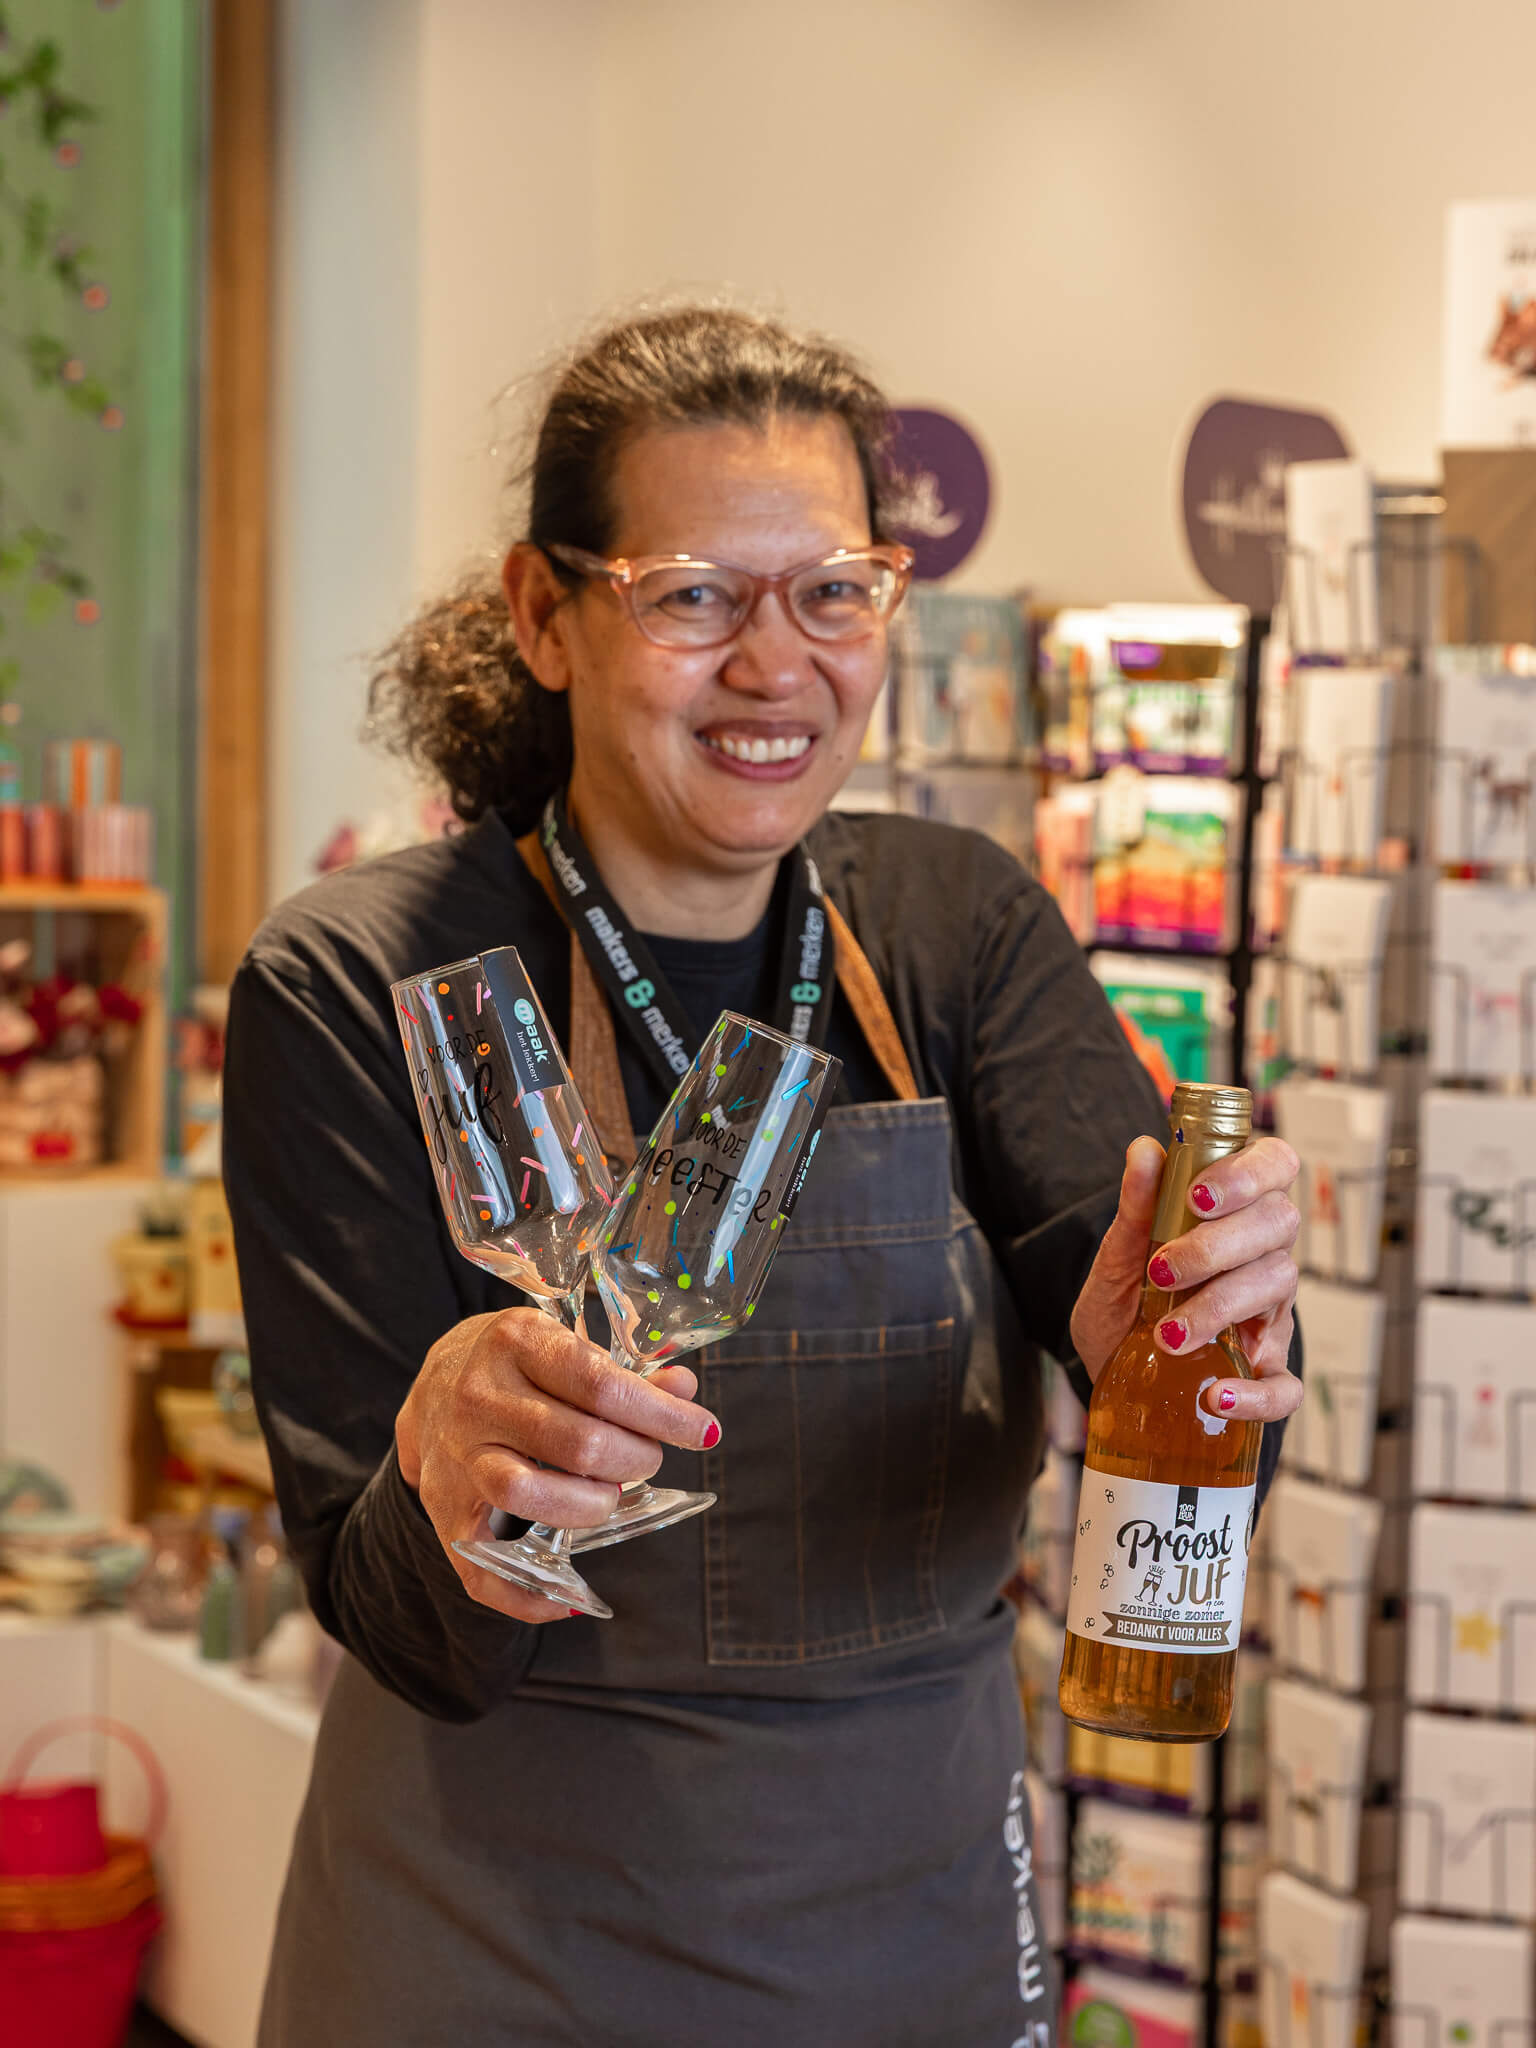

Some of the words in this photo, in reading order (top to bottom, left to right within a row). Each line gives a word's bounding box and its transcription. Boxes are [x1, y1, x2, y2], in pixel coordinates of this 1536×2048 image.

[585, 905, 639, 982] makers
[624, 978, 655, 1008] &
[641, 1006, 690, 1076] merke
[790, 980, 822, 1004] &
[513, 998, 549, 1064] maak
[516, 1030, 528, 1048] het
[721, 1132, 748, 1159] DE
[1116, 1514, 1234, 1570] Proost
[1166, 1556, 1232, 1605] JUF
[1119, 1603, 1180, 1624] zonnige
[1184, 1609, 1225, 1621] zomer
[1116, 1619, 1167, 1641] BEDANKT
[1167, 1625, 1195, 1641] VOOR
[1195, 1626, 1223, 1641] ALLES
